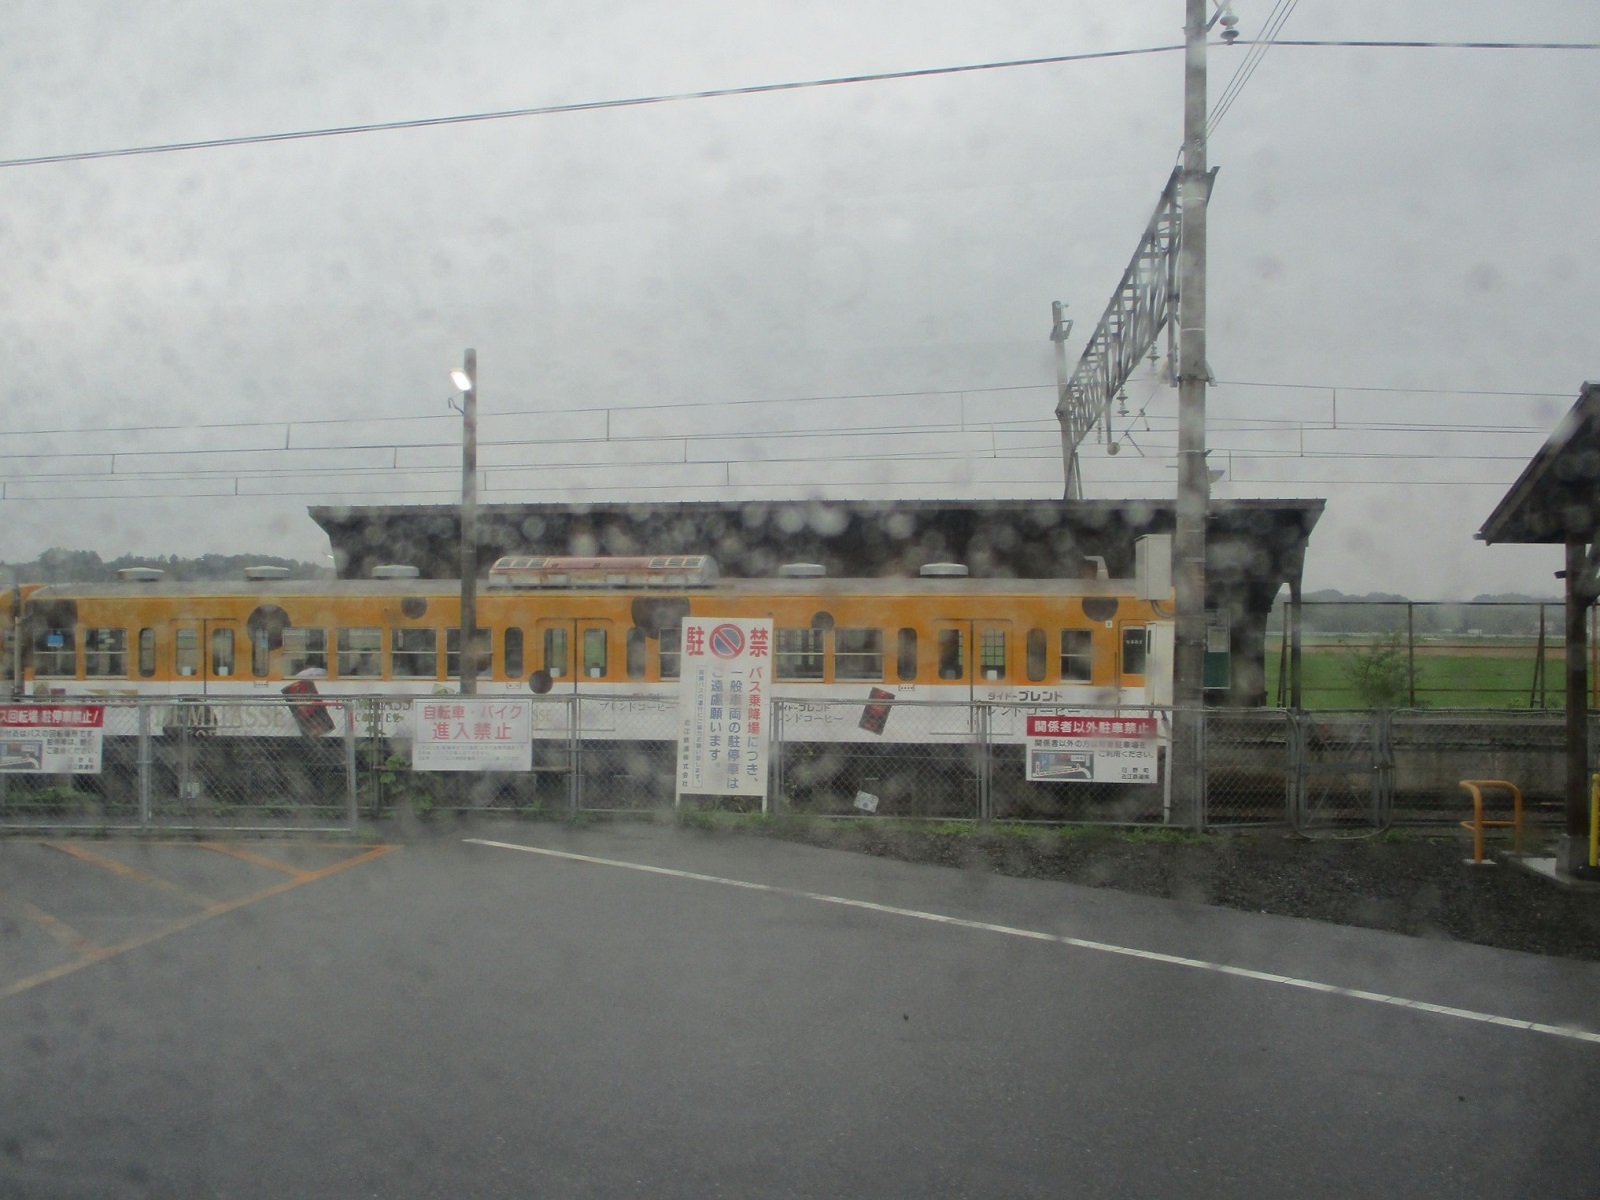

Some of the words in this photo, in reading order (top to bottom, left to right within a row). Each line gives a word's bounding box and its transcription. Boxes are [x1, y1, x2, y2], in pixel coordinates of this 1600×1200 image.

[686, 626, 705, 656] 駐
[749, 627, 768, 657] 禁
[432, 722, 512, 740] 進入禁止
[746, 666, 763, 782] バス乗降場につき、
[1034, 720, 1149, 735] 関係者以外駐車禁止
